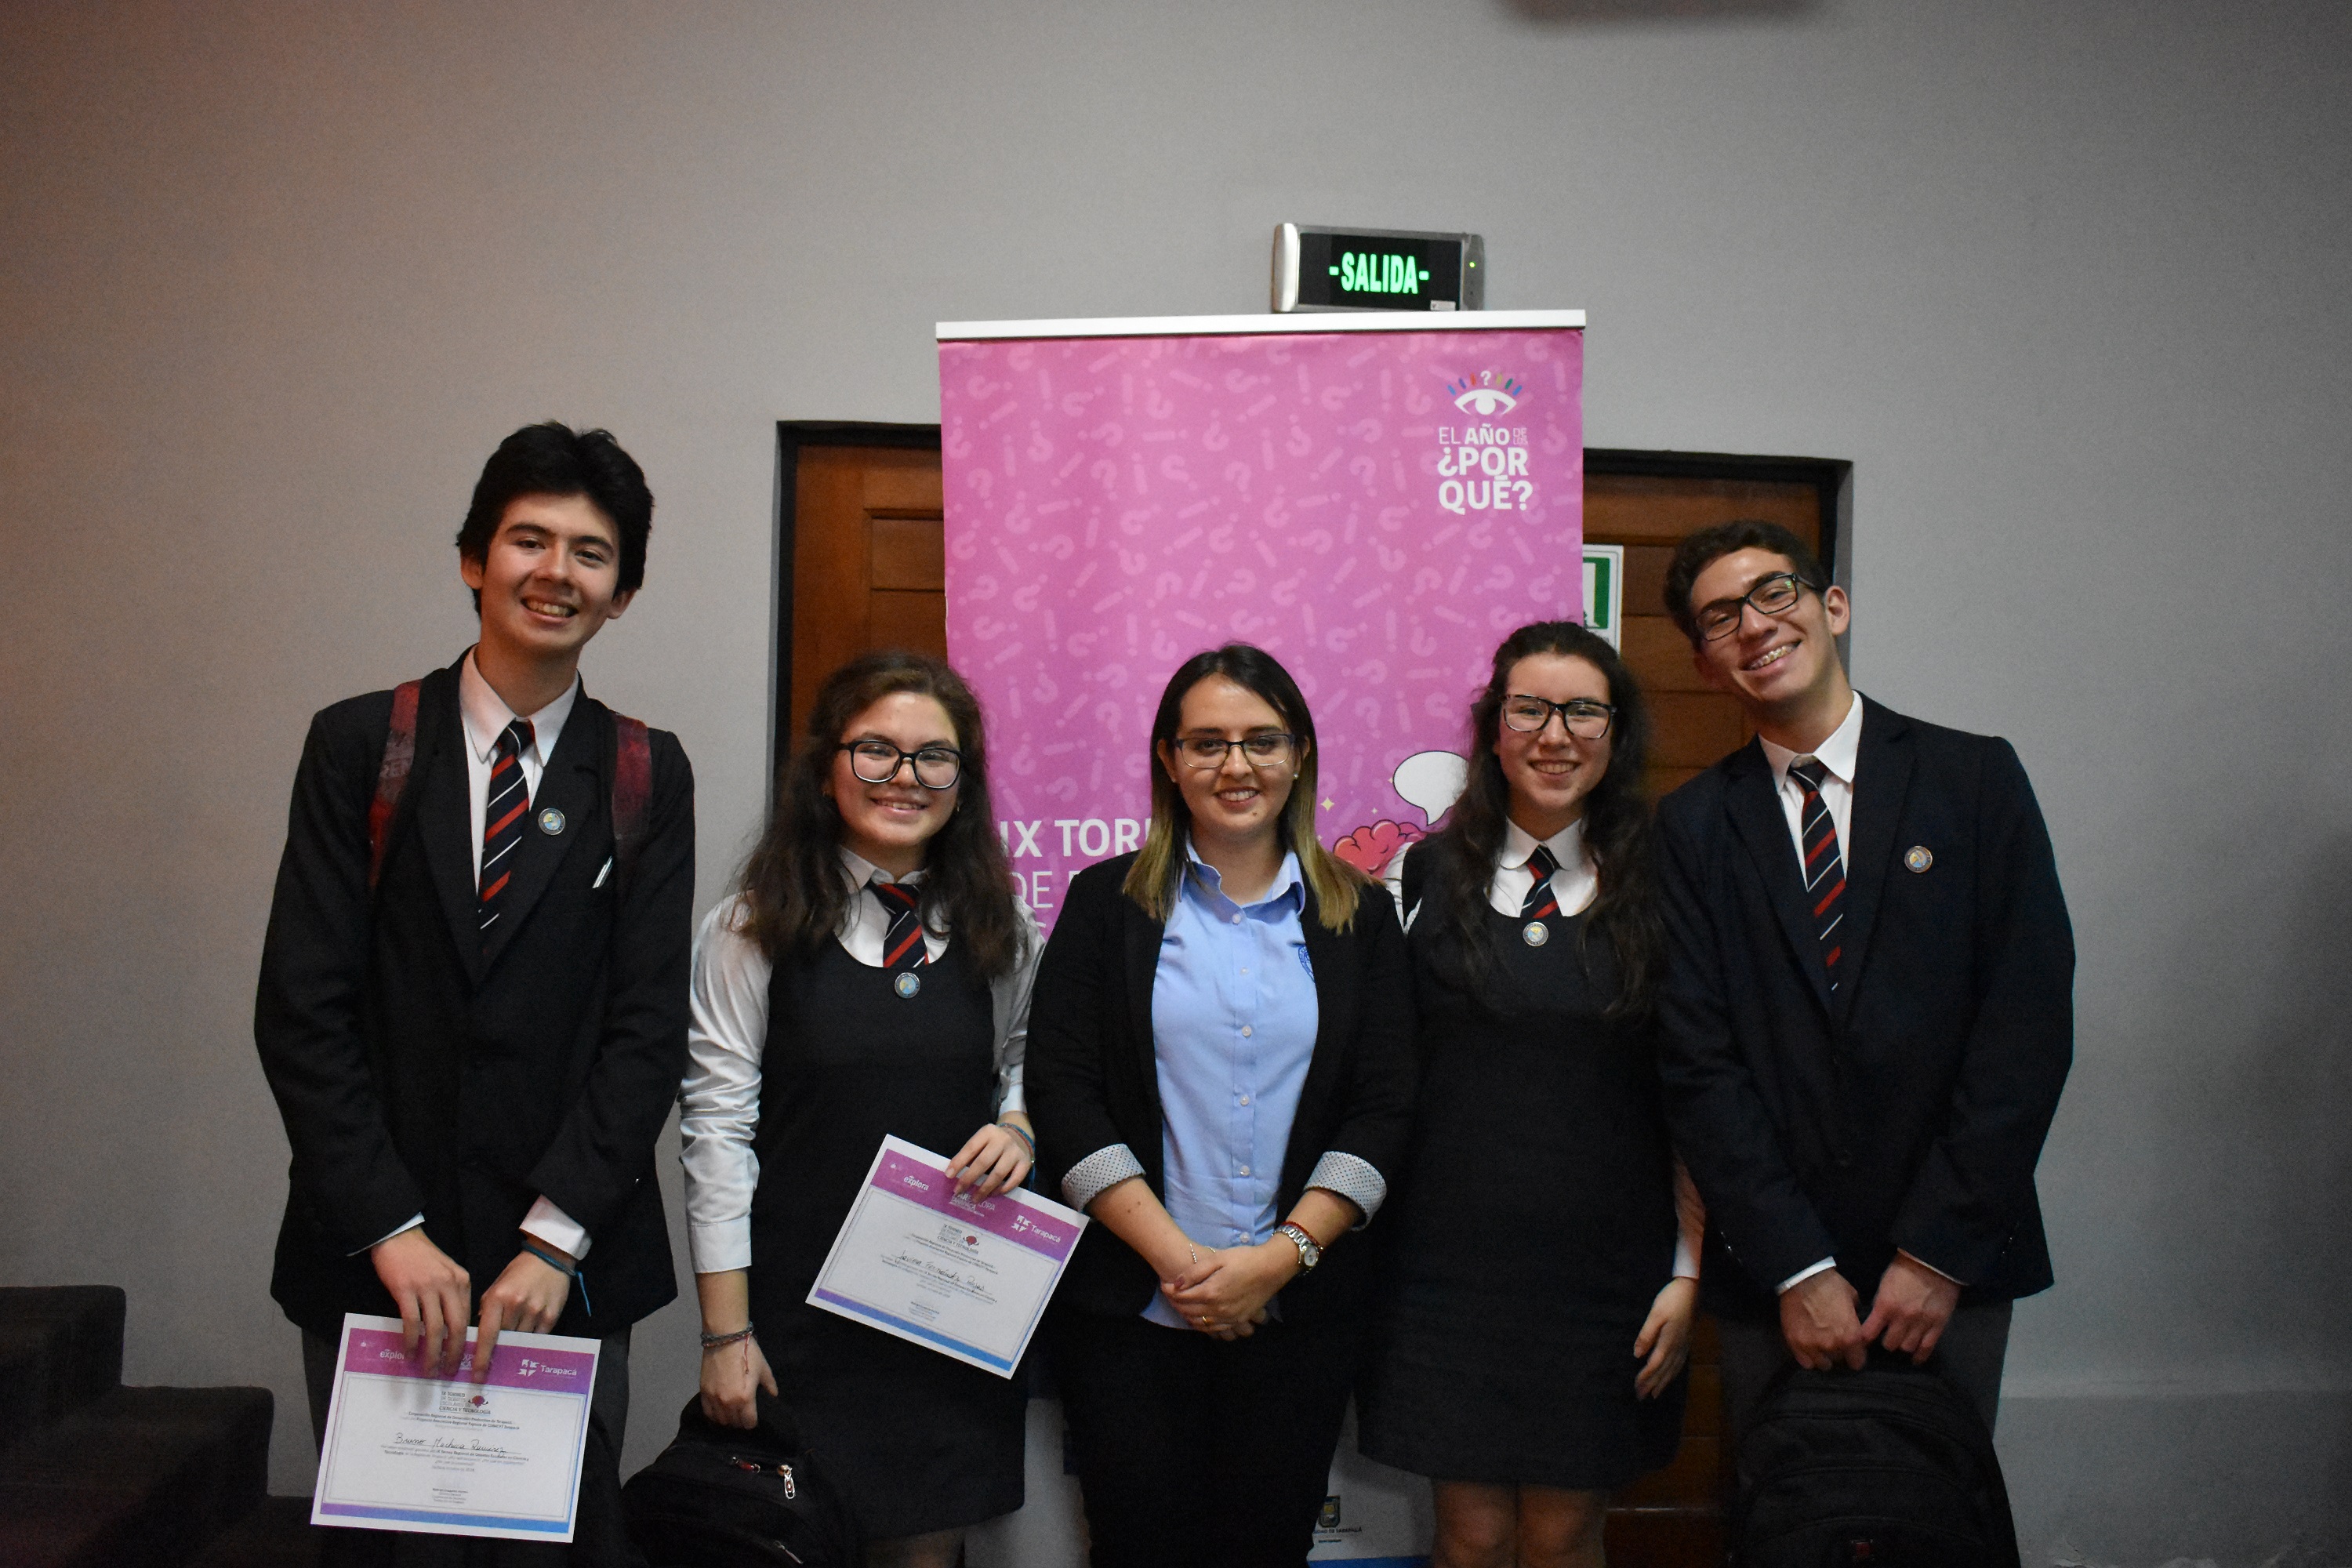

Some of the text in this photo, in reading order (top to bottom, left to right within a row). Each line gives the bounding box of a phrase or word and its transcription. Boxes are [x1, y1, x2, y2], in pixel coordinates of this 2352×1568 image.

[1439, 426, 1460, 445] EL
[1465, 423, 1510, 445] AÑO
[1438, 447, 1528, 476] ¿POR
[1439, 476, 1533, 514] QUÉ?
[904, 1175, 929, 1191] explora
[1031, 1225, 1062, 1243] Tarapacá
[540, 1364, 578, 1377] Tarapacá
